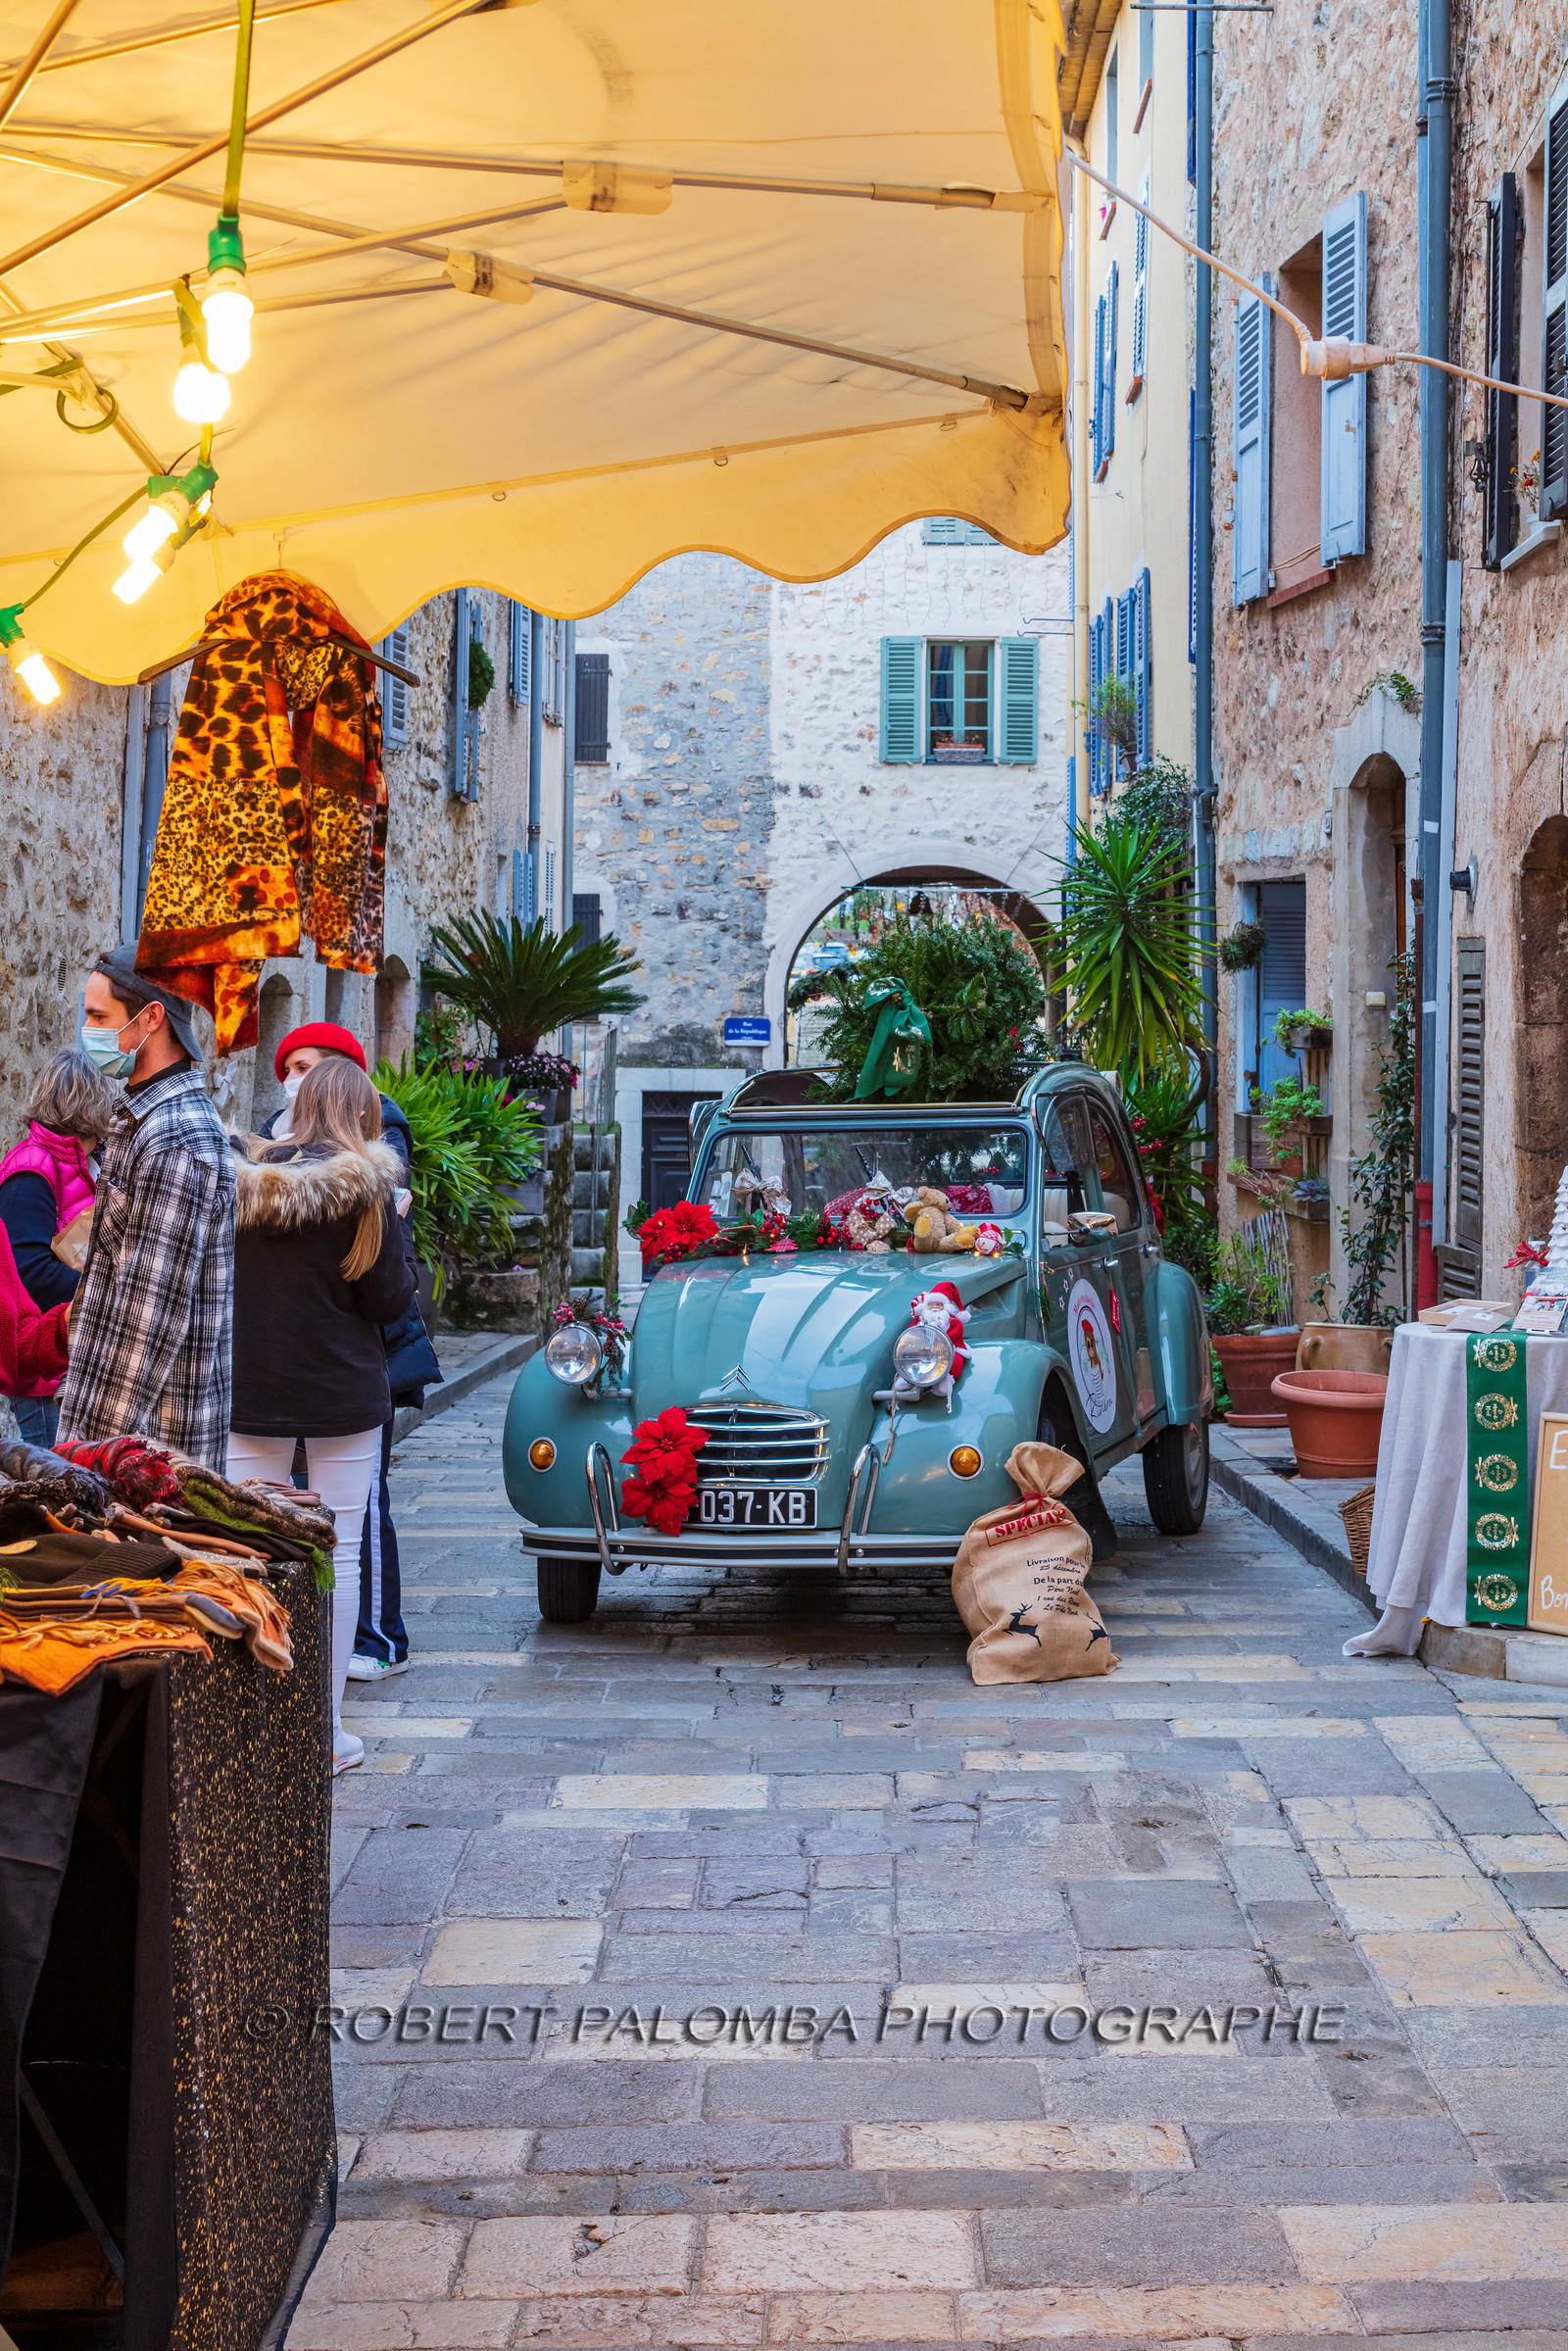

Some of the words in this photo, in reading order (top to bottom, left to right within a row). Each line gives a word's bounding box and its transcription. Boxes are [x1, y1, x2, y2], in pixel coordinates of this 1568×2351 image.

[682, 1491, 807, 1524] -037-KB
[1026, 1556, 1064, 1567] Livraison
[1053, 1564, 1081, 1574] décembre
